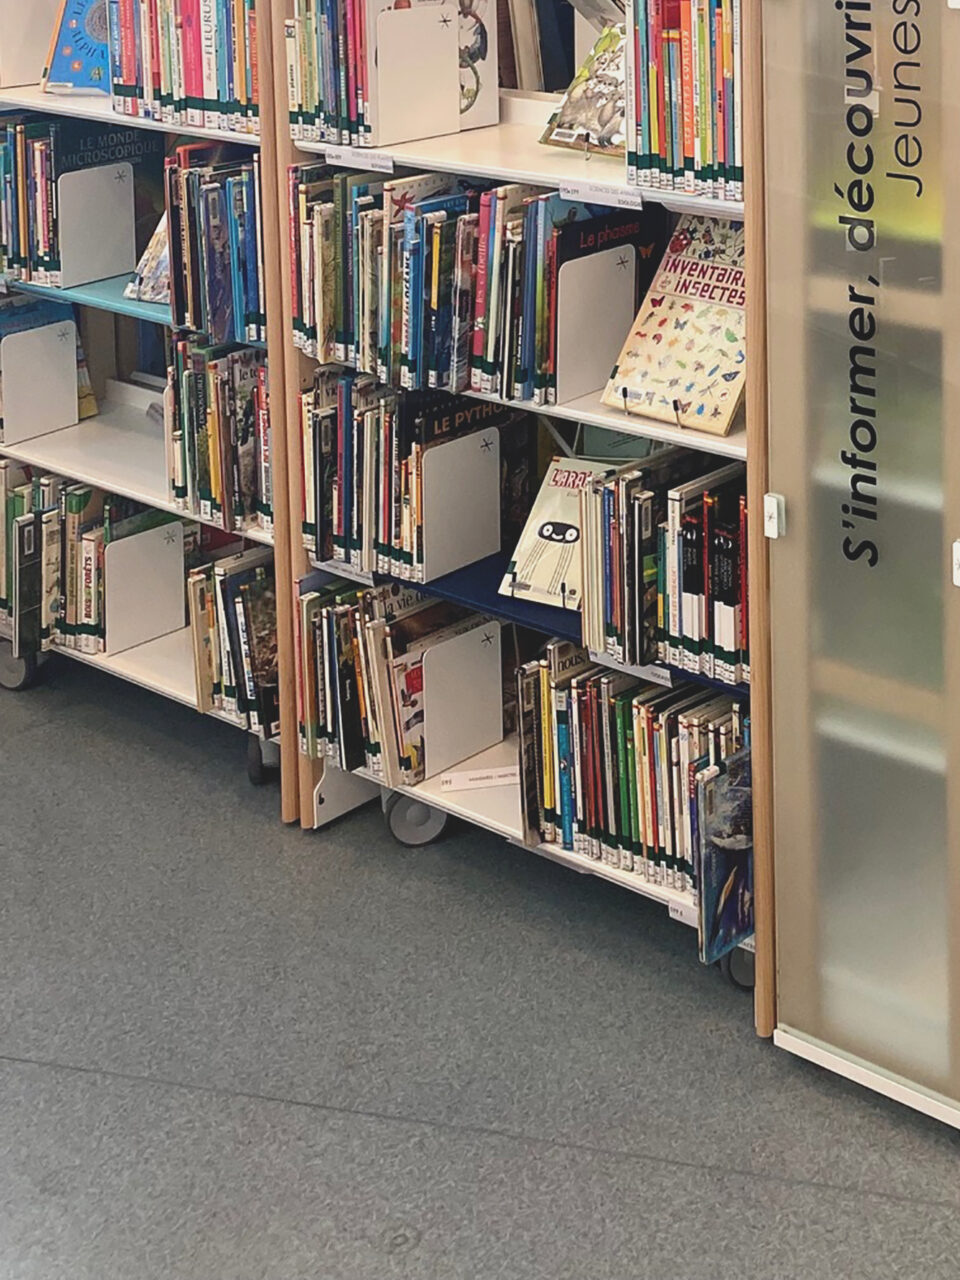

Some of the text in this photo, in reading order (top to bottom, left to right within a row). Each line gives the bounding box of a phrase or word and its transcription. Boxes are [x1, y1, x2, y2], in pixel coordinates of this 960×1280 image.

[61, 140, 159, 167] MICROSCOPIQUE
[80, 129, 140, 150] LE MONDE
[580, 222, 640, 248] Le phasme
[196, 374, 206, 425] DINOSAURES
[434, 402, 508, 435] LE PYTHO
[841, 276, 879, 568] S'informer,
[83, 556, 92, 589] FORÊTS
[84, 599, 92, 619] BOIS
